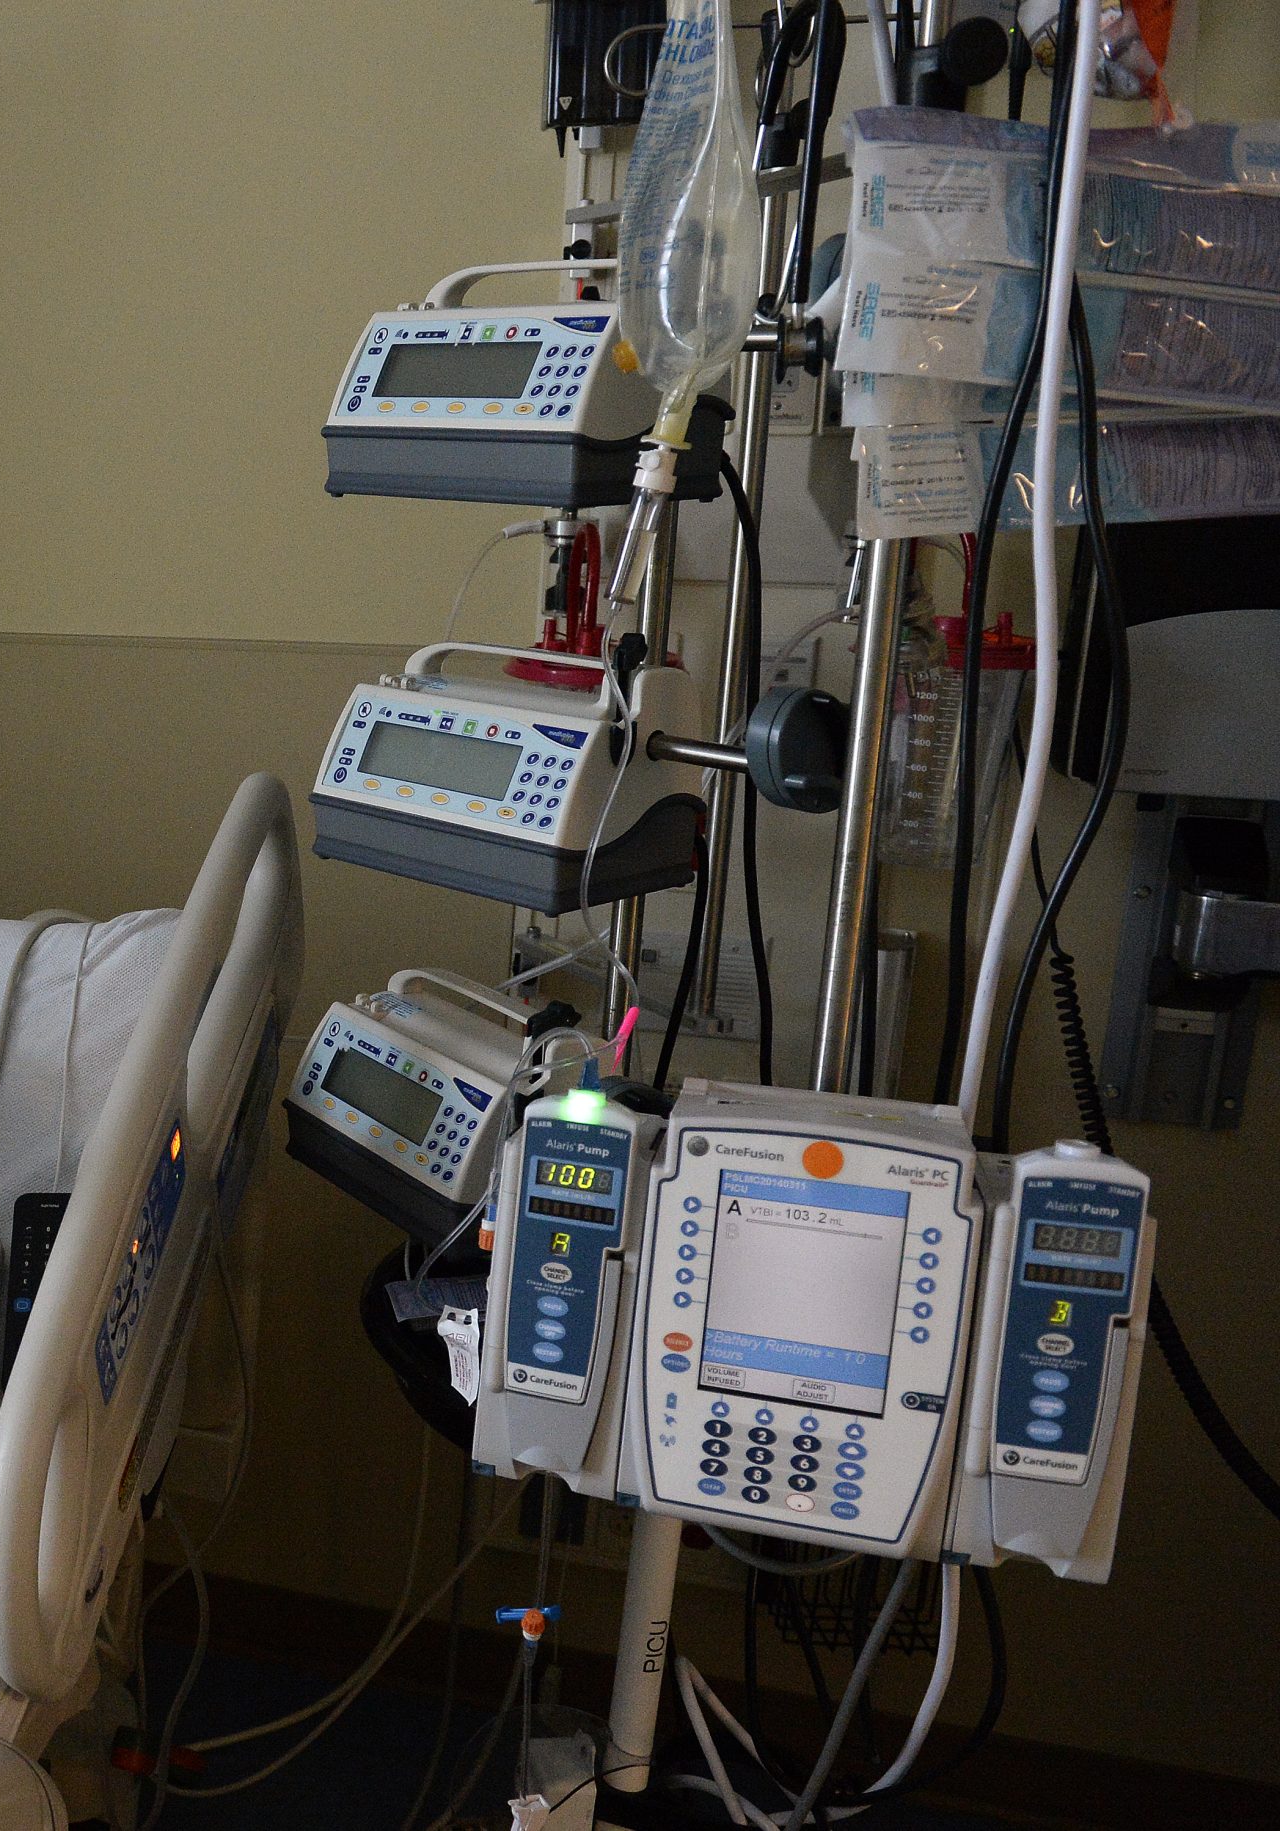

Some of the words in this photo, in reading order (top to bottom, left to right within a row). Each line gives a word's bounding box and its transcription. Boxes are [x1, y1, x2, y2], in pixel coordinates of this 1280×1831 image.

[531, 1120, 553, 1128] ALARM
[600, 1128, 628, 1140] STANDBY
[545, 1139, 574, 1151] Alaris
[577, 1143, 610, 1158] Pump
[715, 1144, 785, 1162] CareFusion
[547, 1164, 596, 1189] 100
[932, 1169, 950, 1181] PC
[723, 1183, 748, 1194] PICU
[727, 1199, 742, 1216] A
[829, 1217, 844, 1227] mL
[1082, 1203, 1120, 1218] Pump
[552, 1232, 570, 1253] A
[543, 1266, 569, 1276] CHANNEL
[547, 1273, 566, 1281] SELECT
[765, 1339, 822, 1358] Runtime
[707, 1367, 740, 1378] VOLUME
[707, 1375, 741, 1386] INFUSED
[529, 1374, 578, 1391] CareFusion
[801, 1381, 828, 1392] AUDIO
[796, 1389, 830, 1402] ADJUST
[715, 1423, 721, 1434] 1
[758, 1430, 768, 1442] 2
[803, 1438, 812, 1450] 3
[711, 1443, 721, 1454] 4
[756, 1451, 765, 1462] 5
[800, 1458, 810, 1470] 6
[1023, 1455, 1078, 1470] CareFusion
[709, 1462, 719, 1473] 7
[753, 1470, 763, 1481] 8
[797, 1477, 807, 1489] 9
[751, 1489, 761, 1501] 0
[642, 1620, 668, 1674] PICU
